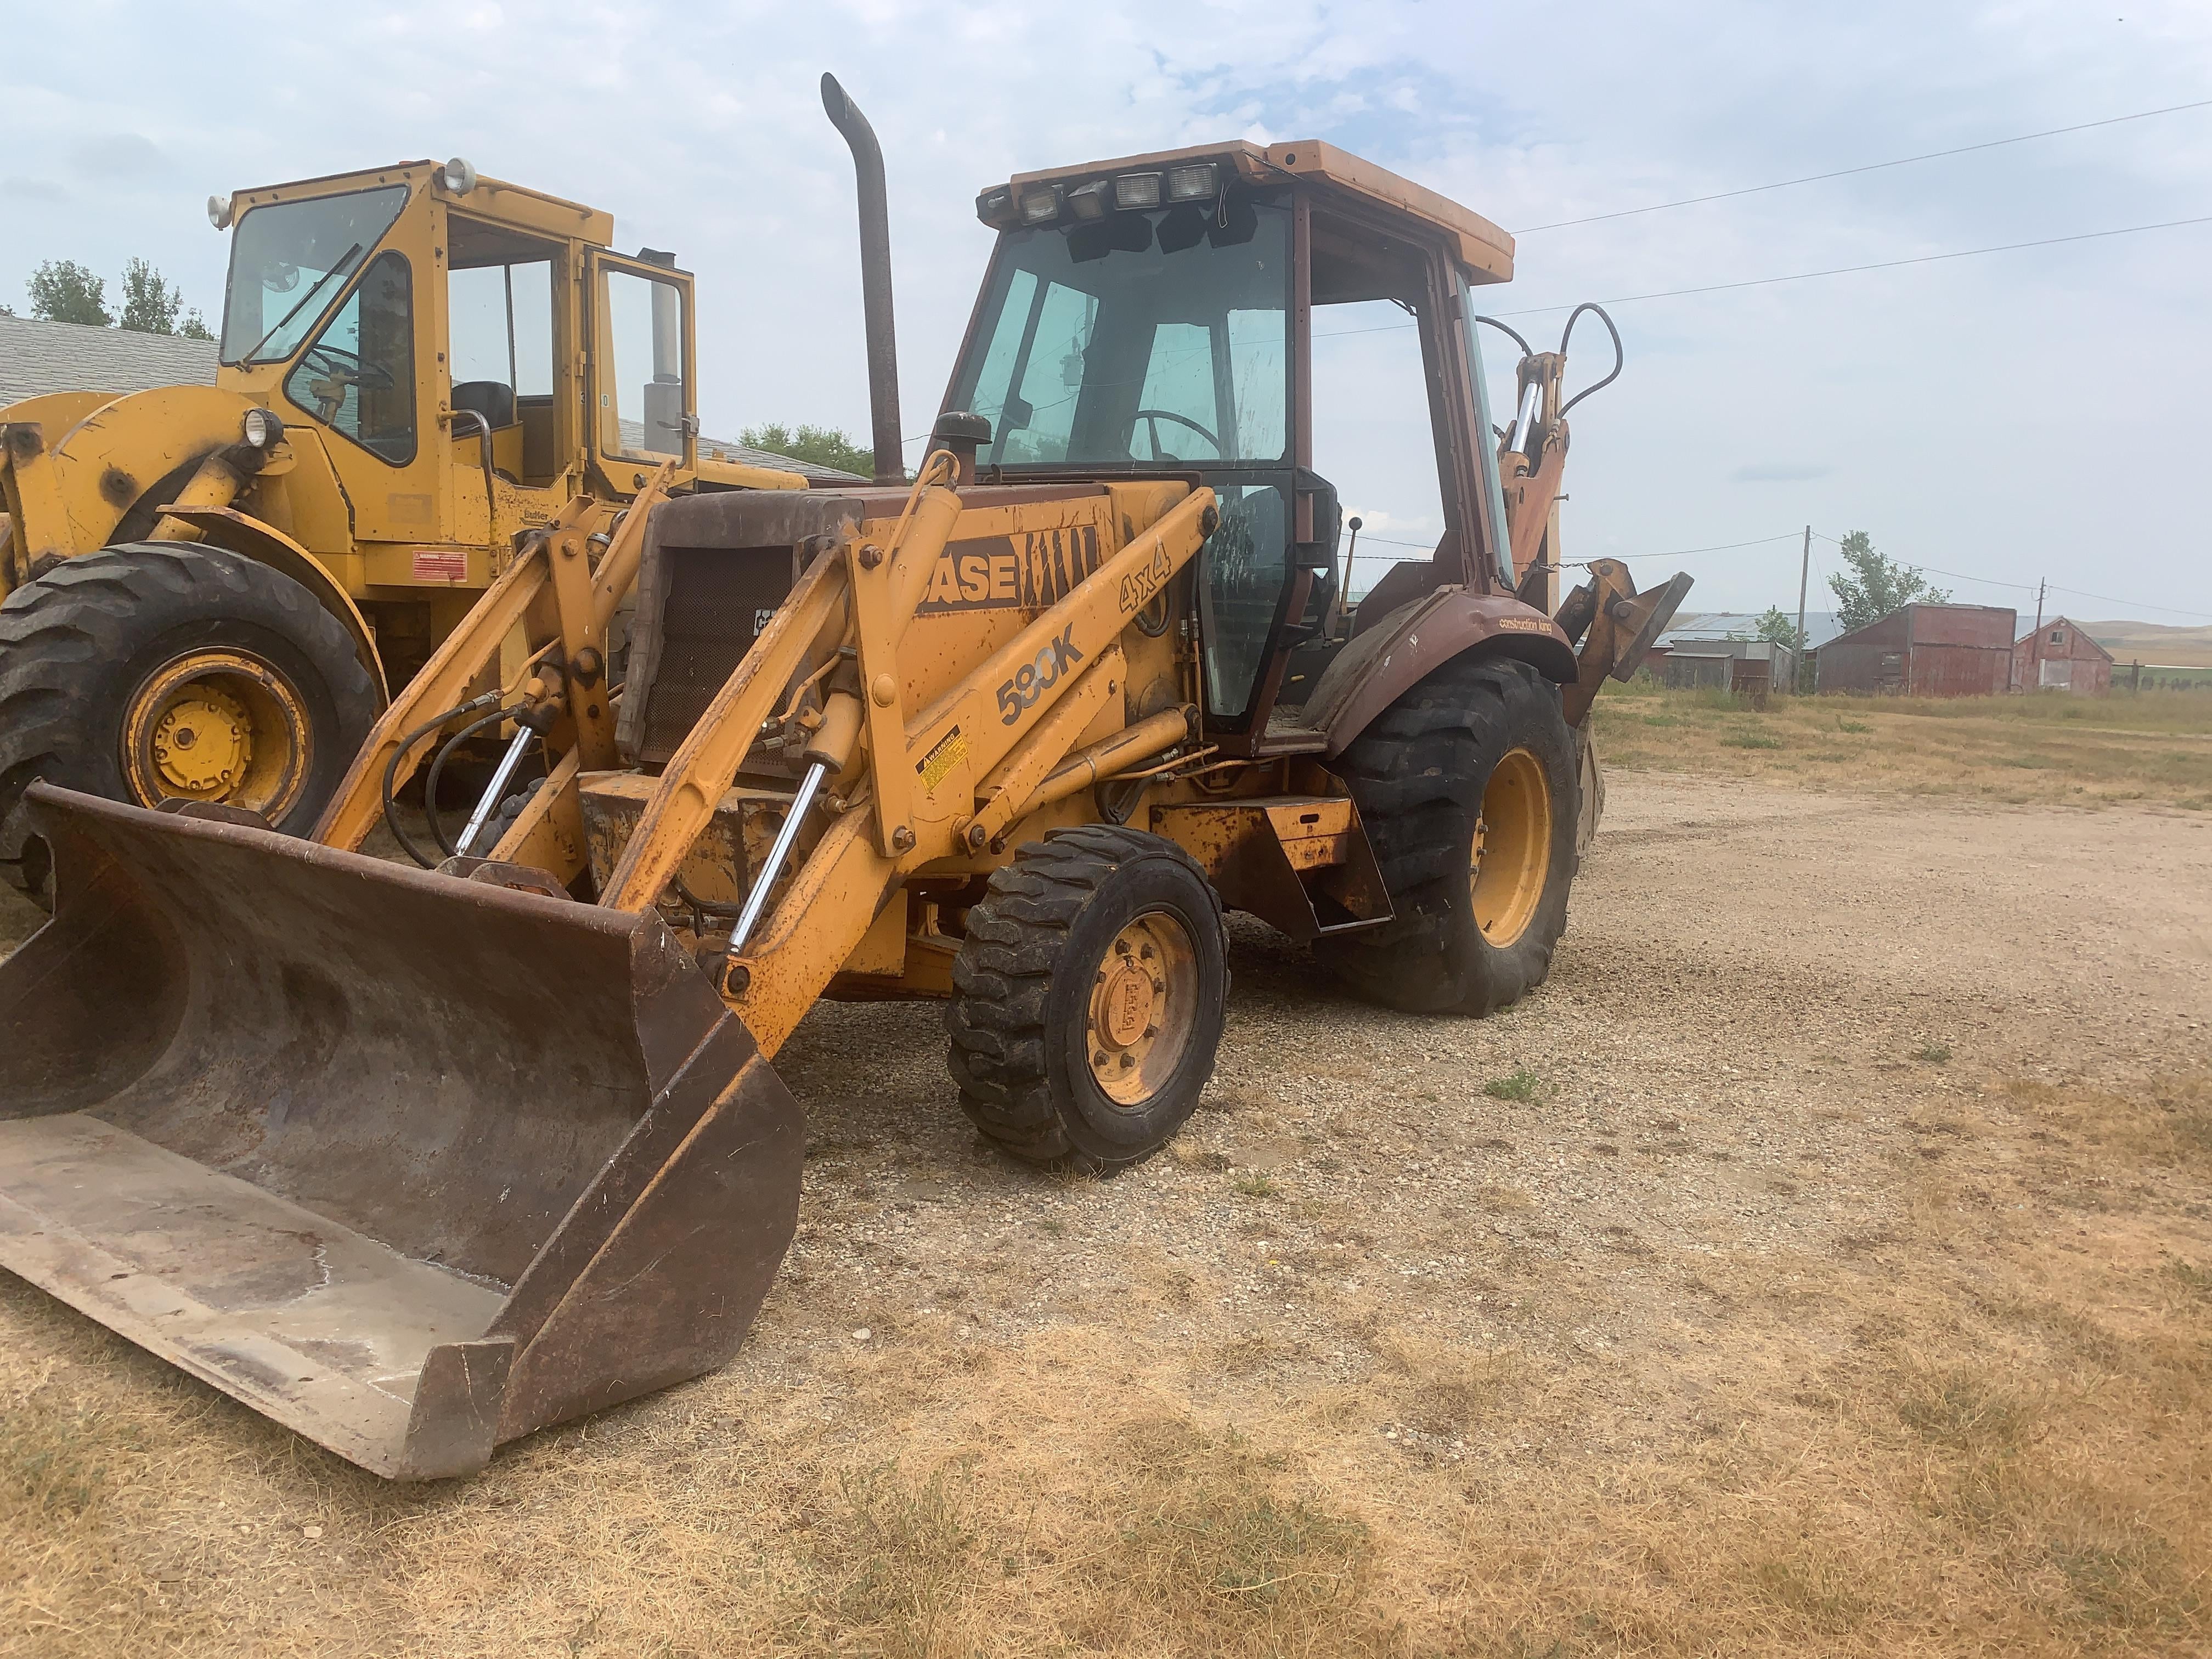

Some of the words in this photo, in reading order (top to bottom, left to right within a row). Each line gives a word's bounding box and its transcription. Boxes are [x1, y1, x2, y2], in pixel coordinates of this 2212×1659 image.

[918, 550, 1017, 604] ASE
[1119, 541, 1172, 614] 4x4
[1499, 618, 1537, 631] construction
[1538, 618, 1553, 635] king
[996, 622, 1085, 726] 580K
[929, 733, 955, 761] WARNING
